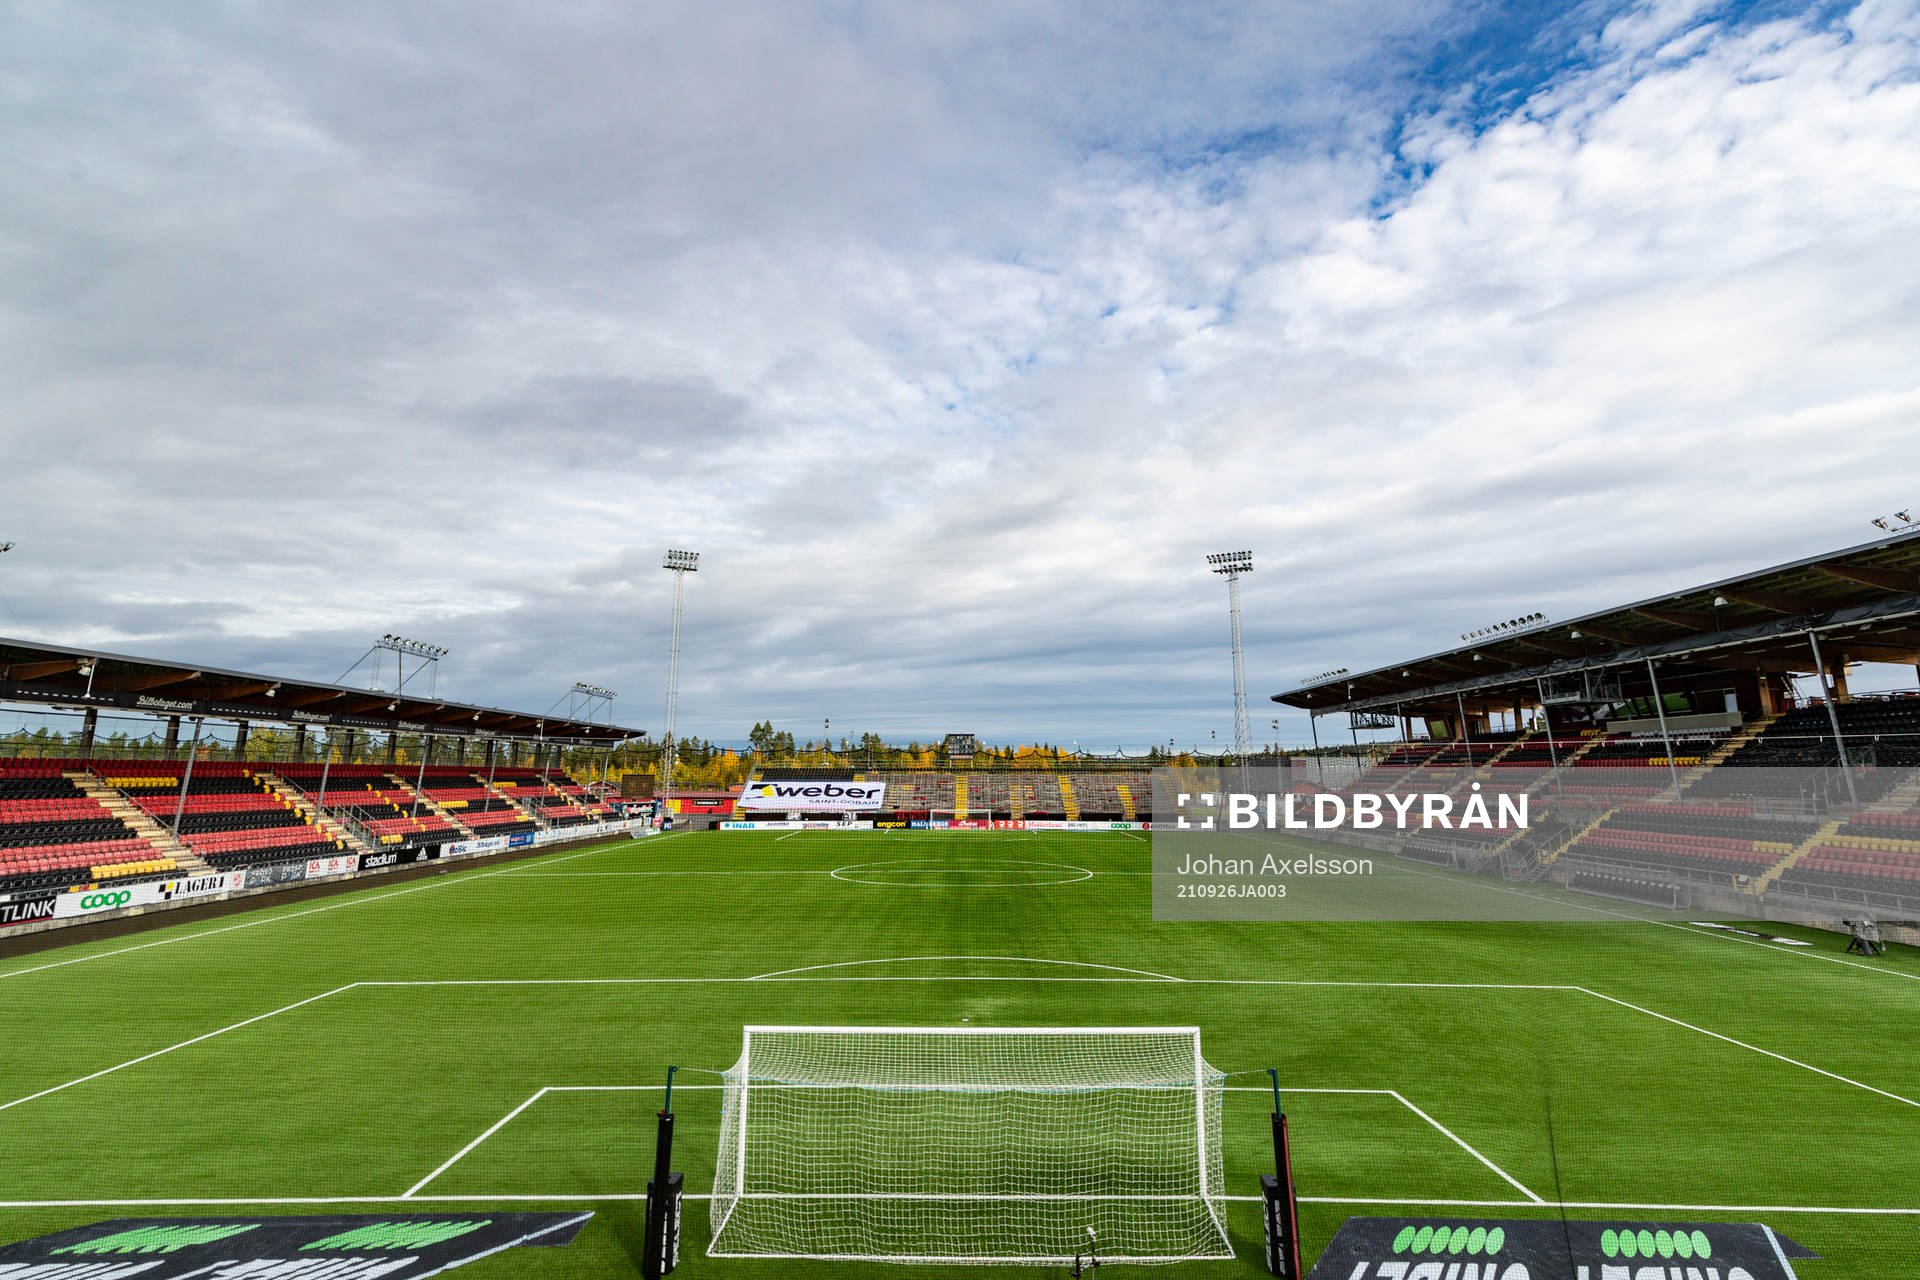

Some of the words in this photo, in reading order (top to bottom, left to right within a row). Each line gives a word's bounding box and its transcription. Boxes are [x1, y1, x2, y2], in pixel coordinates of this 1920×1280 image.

[136, 695, 194, 711] Bilbolaget.com
[776, 784, 881, 799] weber
[876, 821, 906, 829] engcon
[1110, 822, 1131, 830] coop
[308, 860, 320, 871] ICA
[327, 858, 339, 869] ICA
[346, 856, 356, 867] ICA
[365, 853, 397, 868] stadium
[175, 877, 217, 895] LAGER
[80, 890, 132, 910] coop
[0, 900, 56, 922] TLINK
